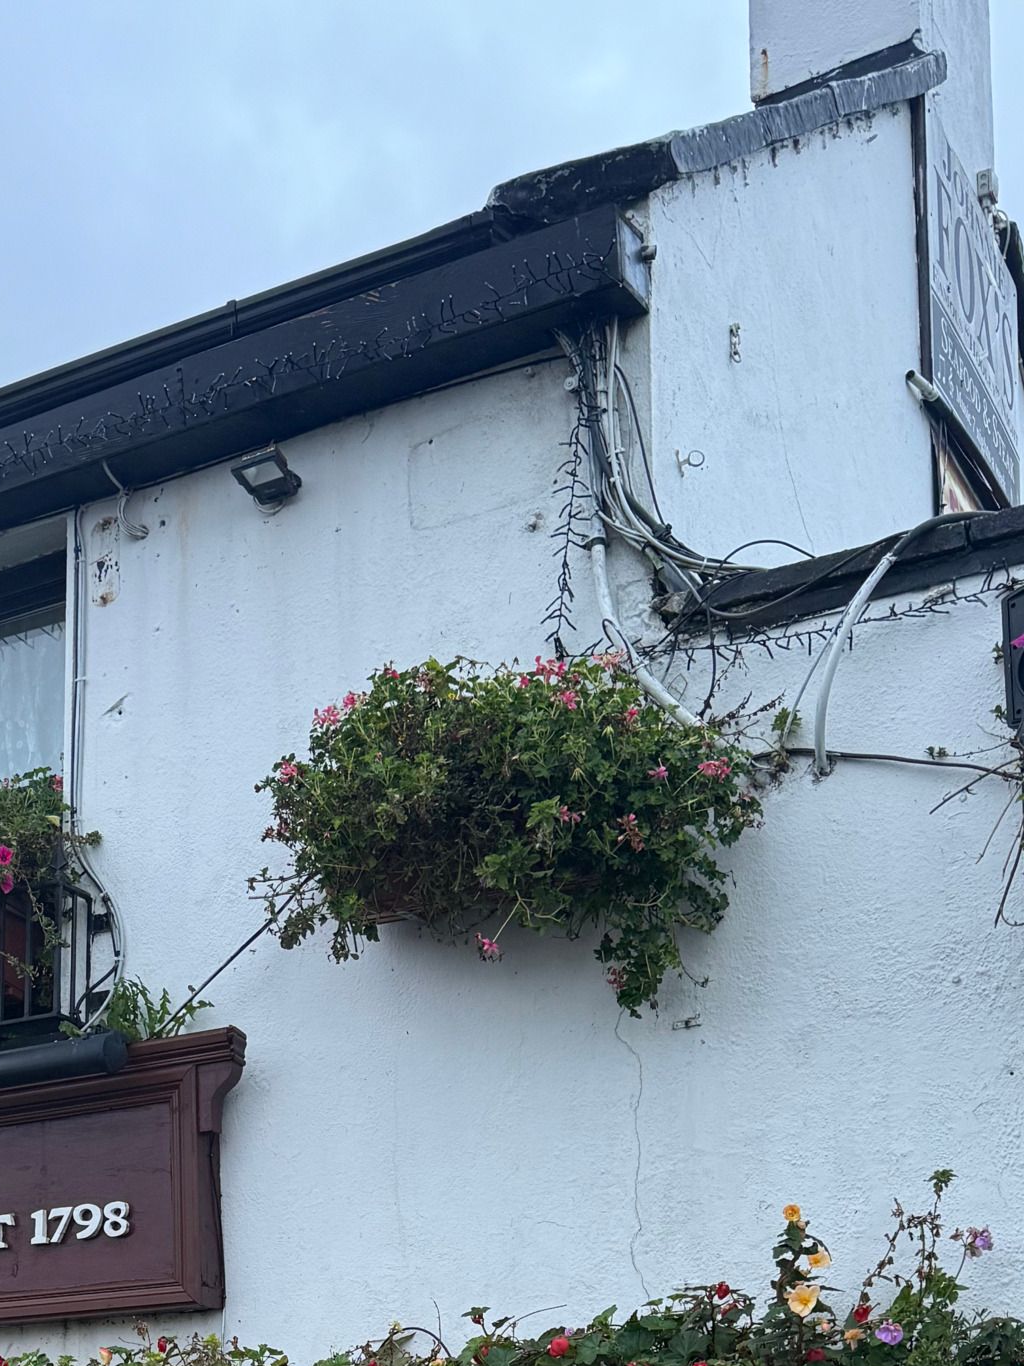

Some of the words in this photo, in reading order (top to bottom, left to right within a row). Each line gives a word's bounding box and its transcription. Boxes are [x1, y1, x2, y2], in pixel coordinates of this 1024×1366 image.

[933, 164, 1013, 411] FOX'S
[941, 316, 981, 414] SEAFOOD
[31, 1201, 131, 1246] 1798
